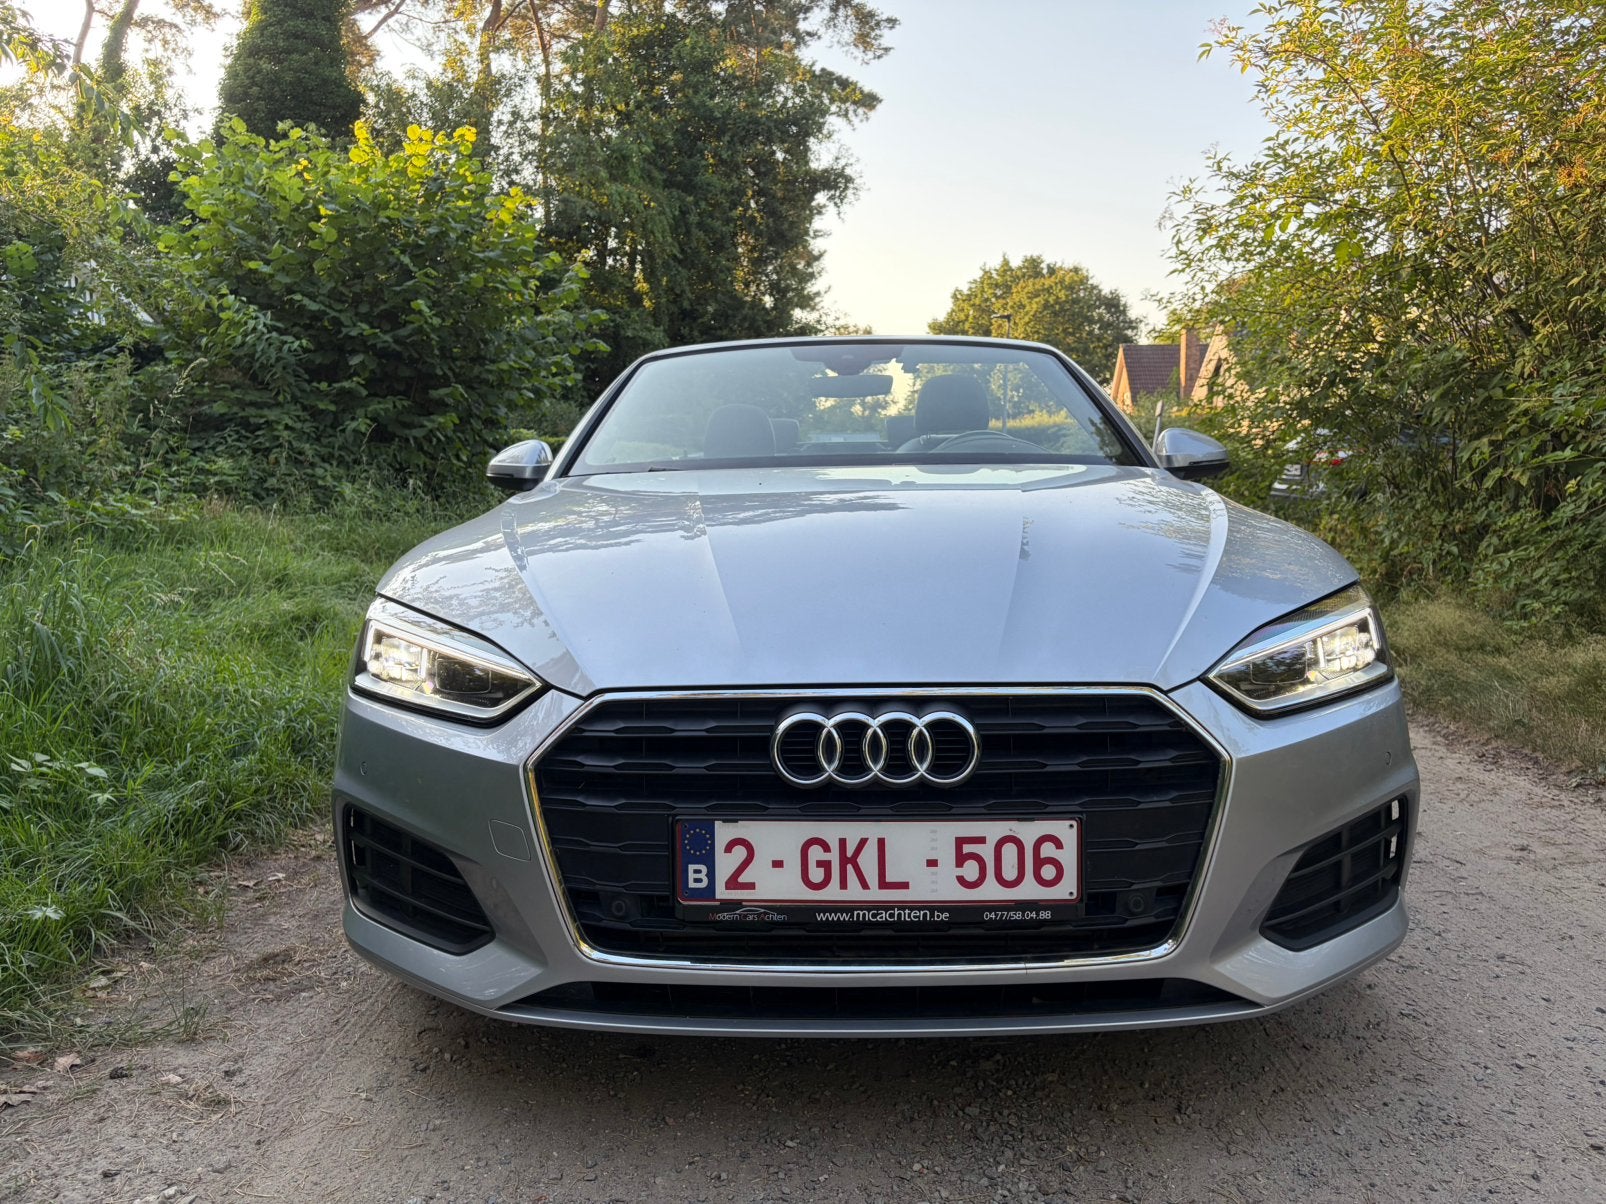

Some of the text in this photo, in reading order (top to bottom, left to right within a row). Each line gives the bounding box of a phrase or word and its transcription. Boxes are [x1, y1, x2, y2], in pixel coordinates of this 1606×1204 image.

[687, 864, 709, 889] B
[708, 912, 788, 921] Modern Cars Achten
[815, 907, 950, 921] www.mcachten.be
[983, 910, 1052, 921] 0477/58.04.88
